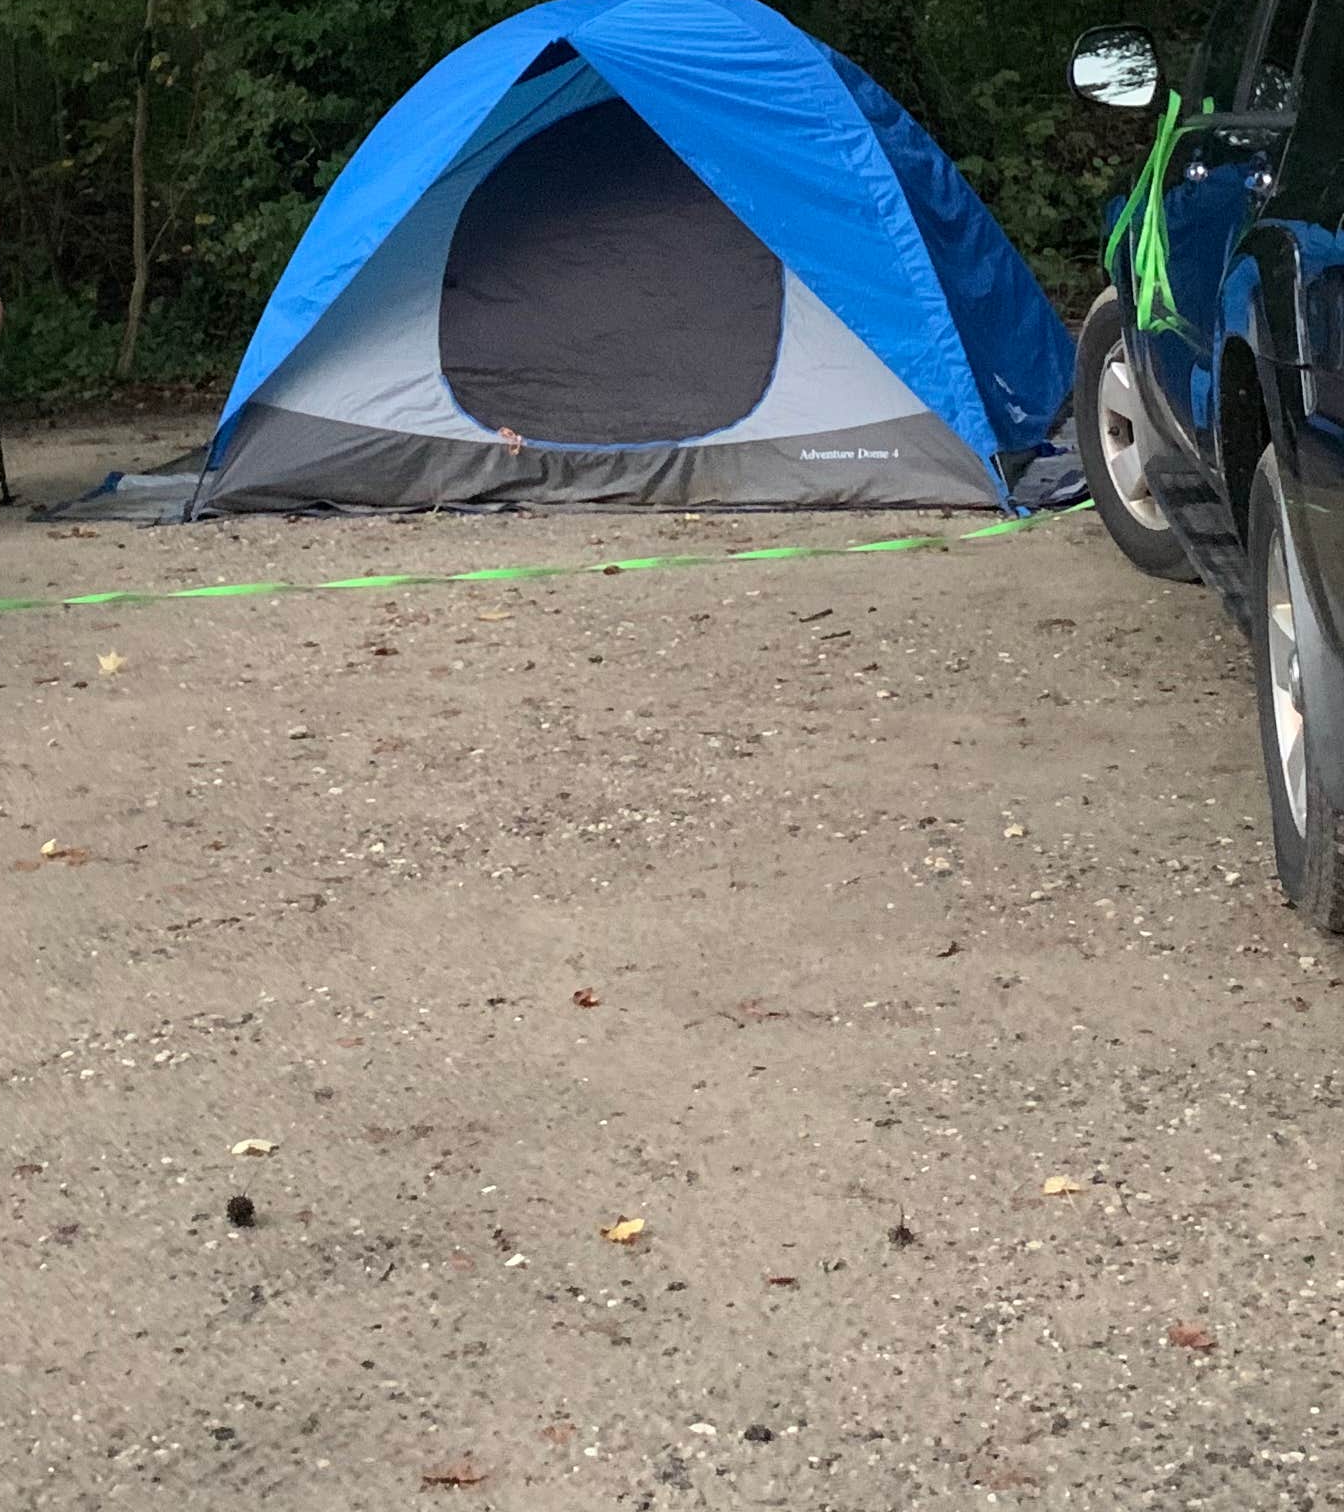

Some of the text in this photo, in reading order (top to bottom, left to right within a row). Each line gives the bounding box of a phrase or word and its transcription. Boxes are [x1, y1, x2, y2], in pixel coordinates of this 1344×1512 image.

[799, 448, 899, 461] Adventure Dome 4
